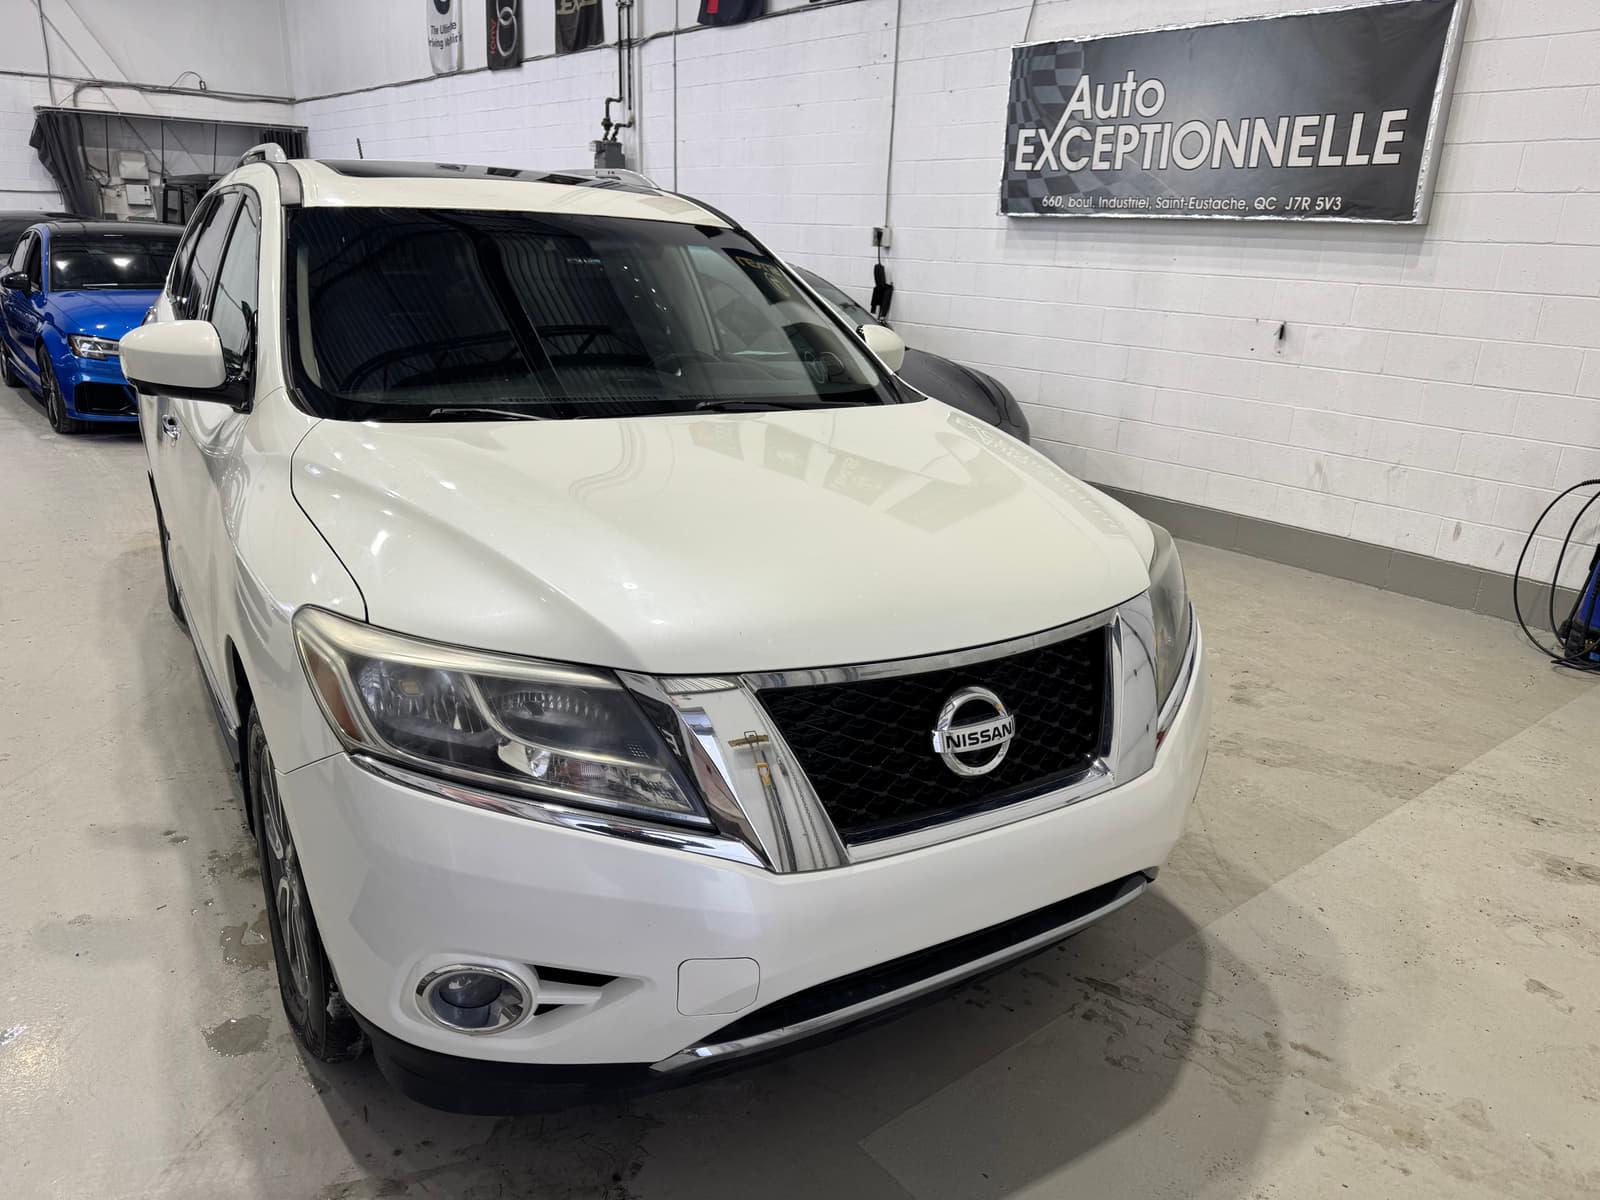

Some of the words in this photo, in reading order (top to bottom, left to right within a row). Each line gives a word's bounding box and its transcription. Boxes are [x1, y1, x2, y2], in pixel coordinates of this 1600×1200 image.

[1064, 71, 1165, 120] Auto
[1013, 109, 1408, 171] EXCEPTIONNELLE
[1041, 195, 1065, 209] 660,
[1067, 196, 1096, 209] boul.
[1098, 196, 1153, 210] Industriel,
[1155, 196, 1249, 211] Saint-Eustache,
[1254, 196, 1277, 211] QC
[1284, 196, 1312, 211] J7R
[1314, 196, 1343, 211] 5V3
[945, 721, 1012, 749] NISSAN
